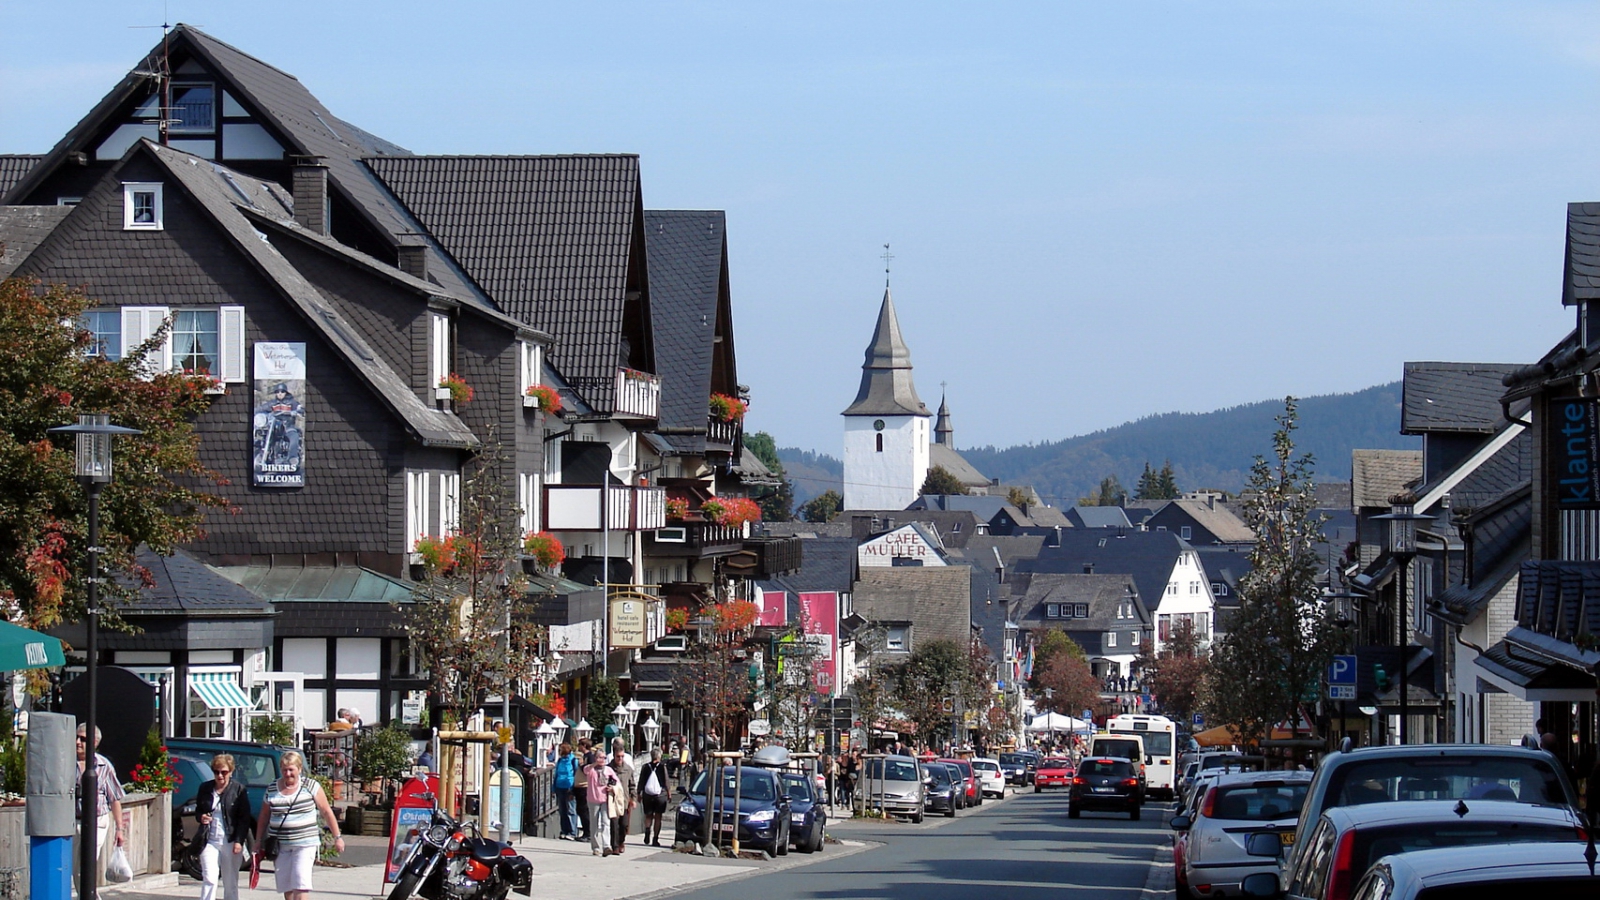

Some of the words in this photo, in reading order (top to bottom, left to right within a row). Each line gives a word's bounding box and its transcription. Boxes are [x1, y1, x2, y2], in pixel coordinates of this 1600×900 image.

[1560, 403, 1590, 503] klante
[261, 464, 297, 472] BIKERS
[256, 474, 302, 483] WELCOME
[1333, 659, 1348, 680] P
